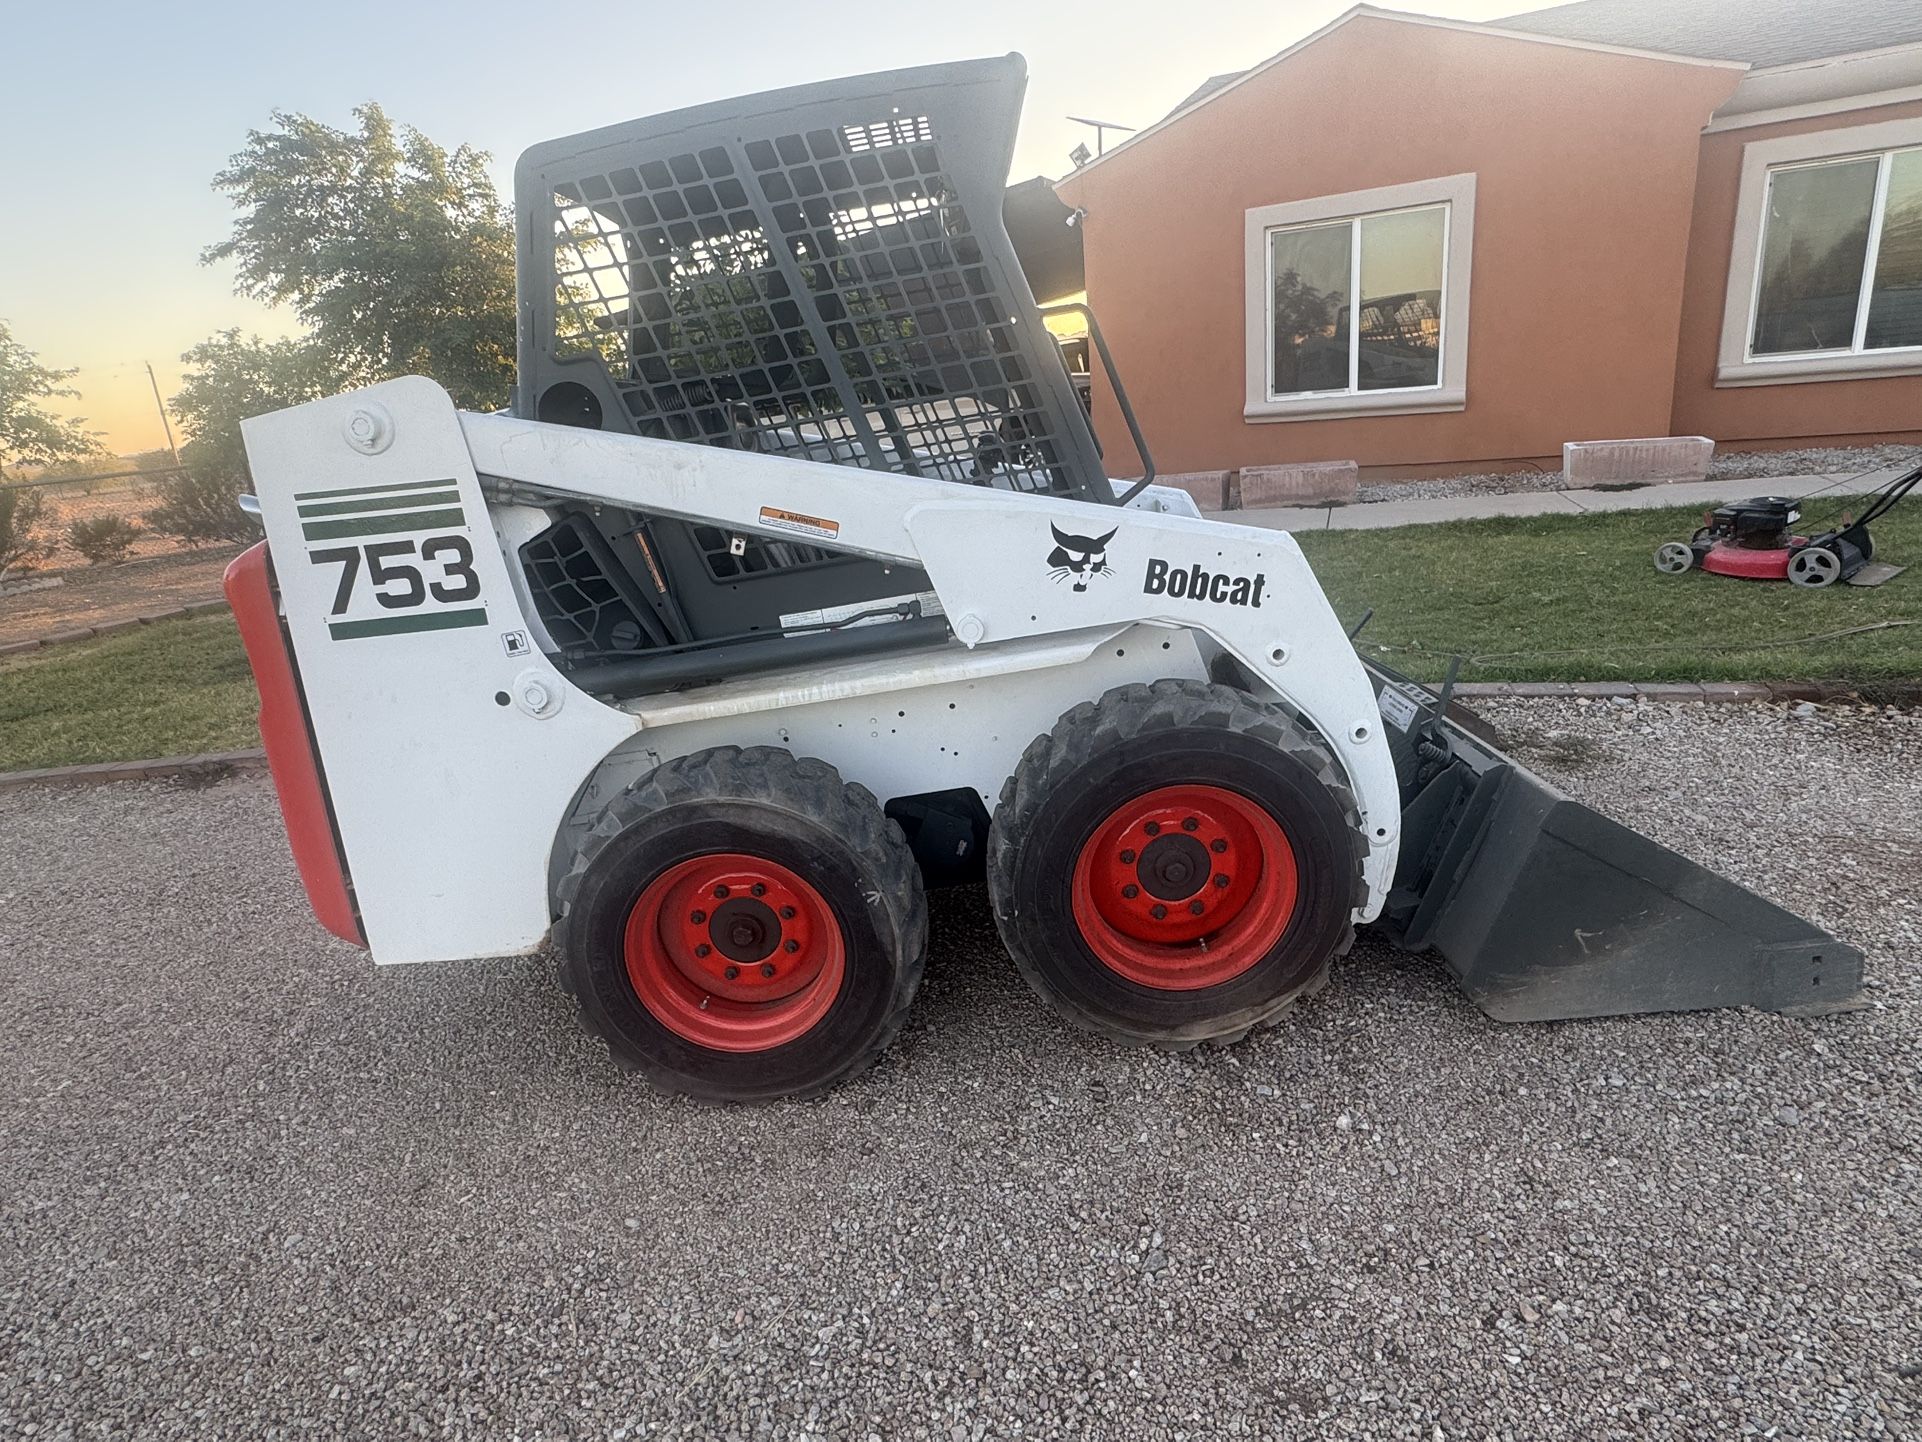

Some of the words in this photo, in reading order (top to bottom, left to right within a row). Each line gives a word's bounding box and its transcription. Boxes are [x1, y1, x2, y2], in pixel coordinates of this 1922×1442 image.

[788, 513, 821, 527] WARNING
[309, 535, 481, 615] 753
[1143, 558, 1265, 608] Bobcat
